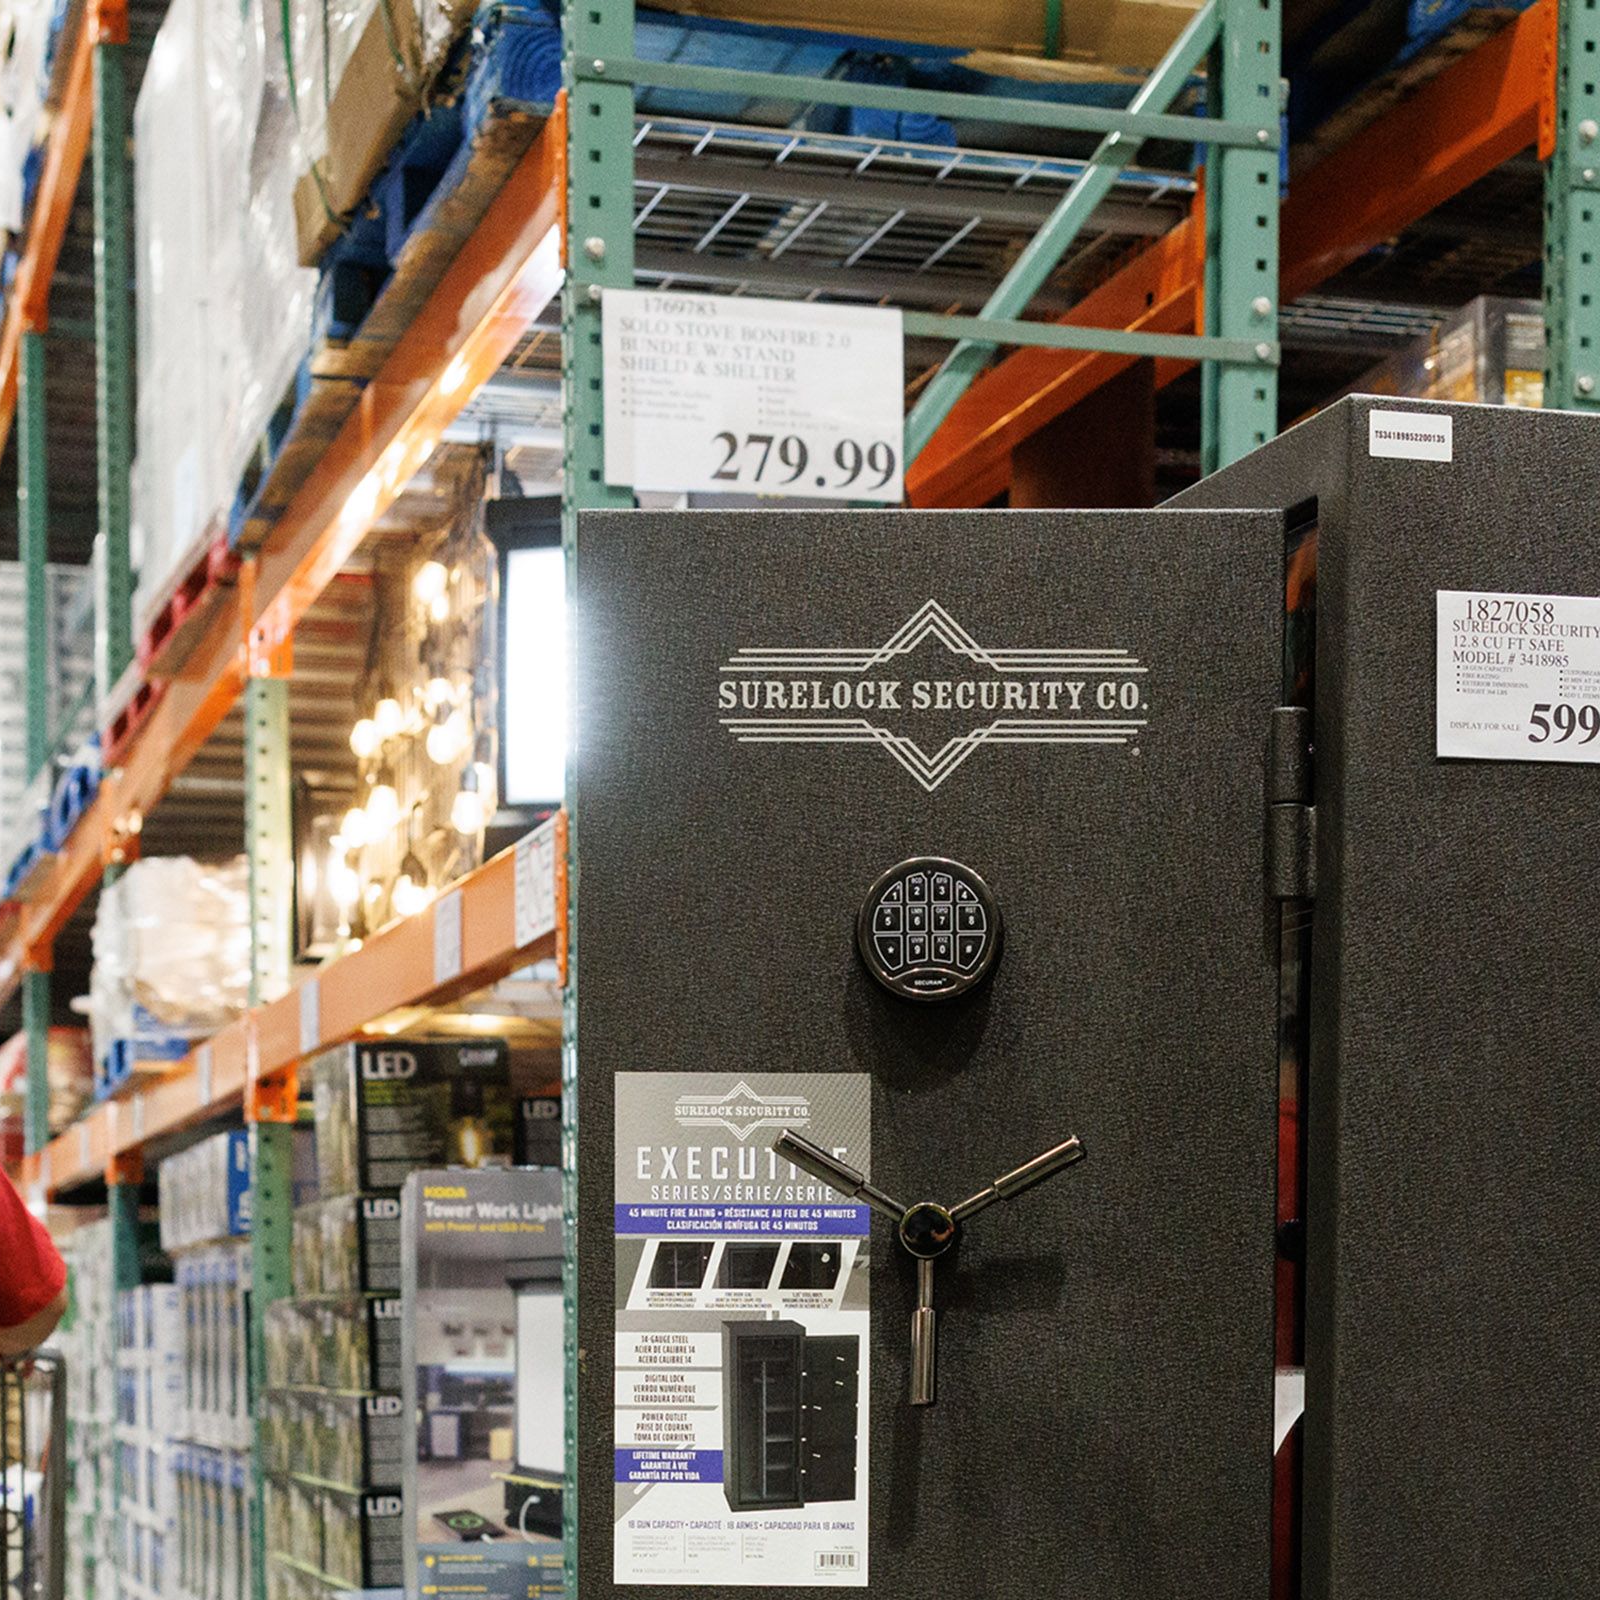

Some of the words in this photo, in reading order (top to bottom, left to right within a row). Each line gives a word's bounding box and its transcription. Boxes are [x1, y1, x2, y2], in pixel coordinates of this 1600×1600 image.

[642, 297, 718, 316] 1769783
[619, 318, 670, 334] SOLO
[675, 320, 736, 341] STOVE
[741, 326, 820, 347] BONFIRE
[826, 332, 851, 348] 2.0
[620, 337, 700, 356] BUNDLE
[733, 344, 796, 363] STAND
[619, 356, 689, 374] SHIELD
[693, 359, 707, 376] &
[713, 361, 797, 382] SHELTER
[710, 432, 897, 491] 279.99
[1465, 599, 1555, 624] 1827058
[1452, 619, 1528, 636] SURELOCK
[1453, 635, 1479, 648] 12.8
[1483, 636, 1503, 649] CU
[1507, 638, 1525, 650] FT
[1529, 639, 1565, 652] SAFE
[1452, 651, 1504, 665] MODEL
[1508, 653, 1515, 665] #
[1520, 653, 1570, 668] 3418985
[718, 680, 901, 711] SURELOCK
[912, 680, 1086, 711] SECURITY
[1096, 680, 1149, 711] CO.
[1449, 720, 1481, 731] DISPLAY
[1484, 722, 1498, 732] FOR
[1501, 722, 1521, 732] SALE
[362, 1051, 418, 1080] LED
[675, 1105, 733, 1117] SURELOCK
[735, 1105, 791, 1117] SECURITY
[793, 1105, 811, 1117] CO.
[637, 1146, 848, 1180] EXECUT
[423, 1203, 473, 1219] Tower
[476, 1203, 519, 1219] Work
[522, 1202, 564, 1222] Ligh
[629, 1209, 640, 1218] 45
[641, 1209, 668, 1218] MINUTE
[670, 1209, 687, 1218] FIRE
[688, 1209, 716, 1218] RATING
[724, 1207, 770, 1218] RÉSISTANCE
[772, 1209, 782, 1218] AU
[784, 1209, 798, 1218] FEU
[800, 1209, 809, 1218] DE
[812, 1209, 822, 1218] 45
[824, 1209, 857, 1218] MINUTES
[666, 1219, 723, 1231] CLASIFICACIÓN
[724, 1219, 759, 1231] IGNÍFUGA
[761, 1221, 770, 1231] DE
[773, 1221, 783, 1231] 45
[785, 1221, 818, 1231] MINUTOS
[644, 1374, 669, 1383] DIGITAL
[670, 1374, 684, 1383] LOCK
[641, 1413, 664, 1421] POWER
[665, 1413, 687, 1421] OUTLET
[628, 1520, 636, 1529] 18
[636, 1520, 651, 1530] GUN
[652, 1520, 685, 1530] CAPACITY
[727, 1521, 735, 1530] 18
[736, 1521, 759, 1531] ARMES
[764, 1521, 802, 1531] CAPACIDAD
[804, 1521, 821, 1531] PARA
[822, 1522, 830, 1531] 18
[831, 1522, 855, 1531] ARMAS
